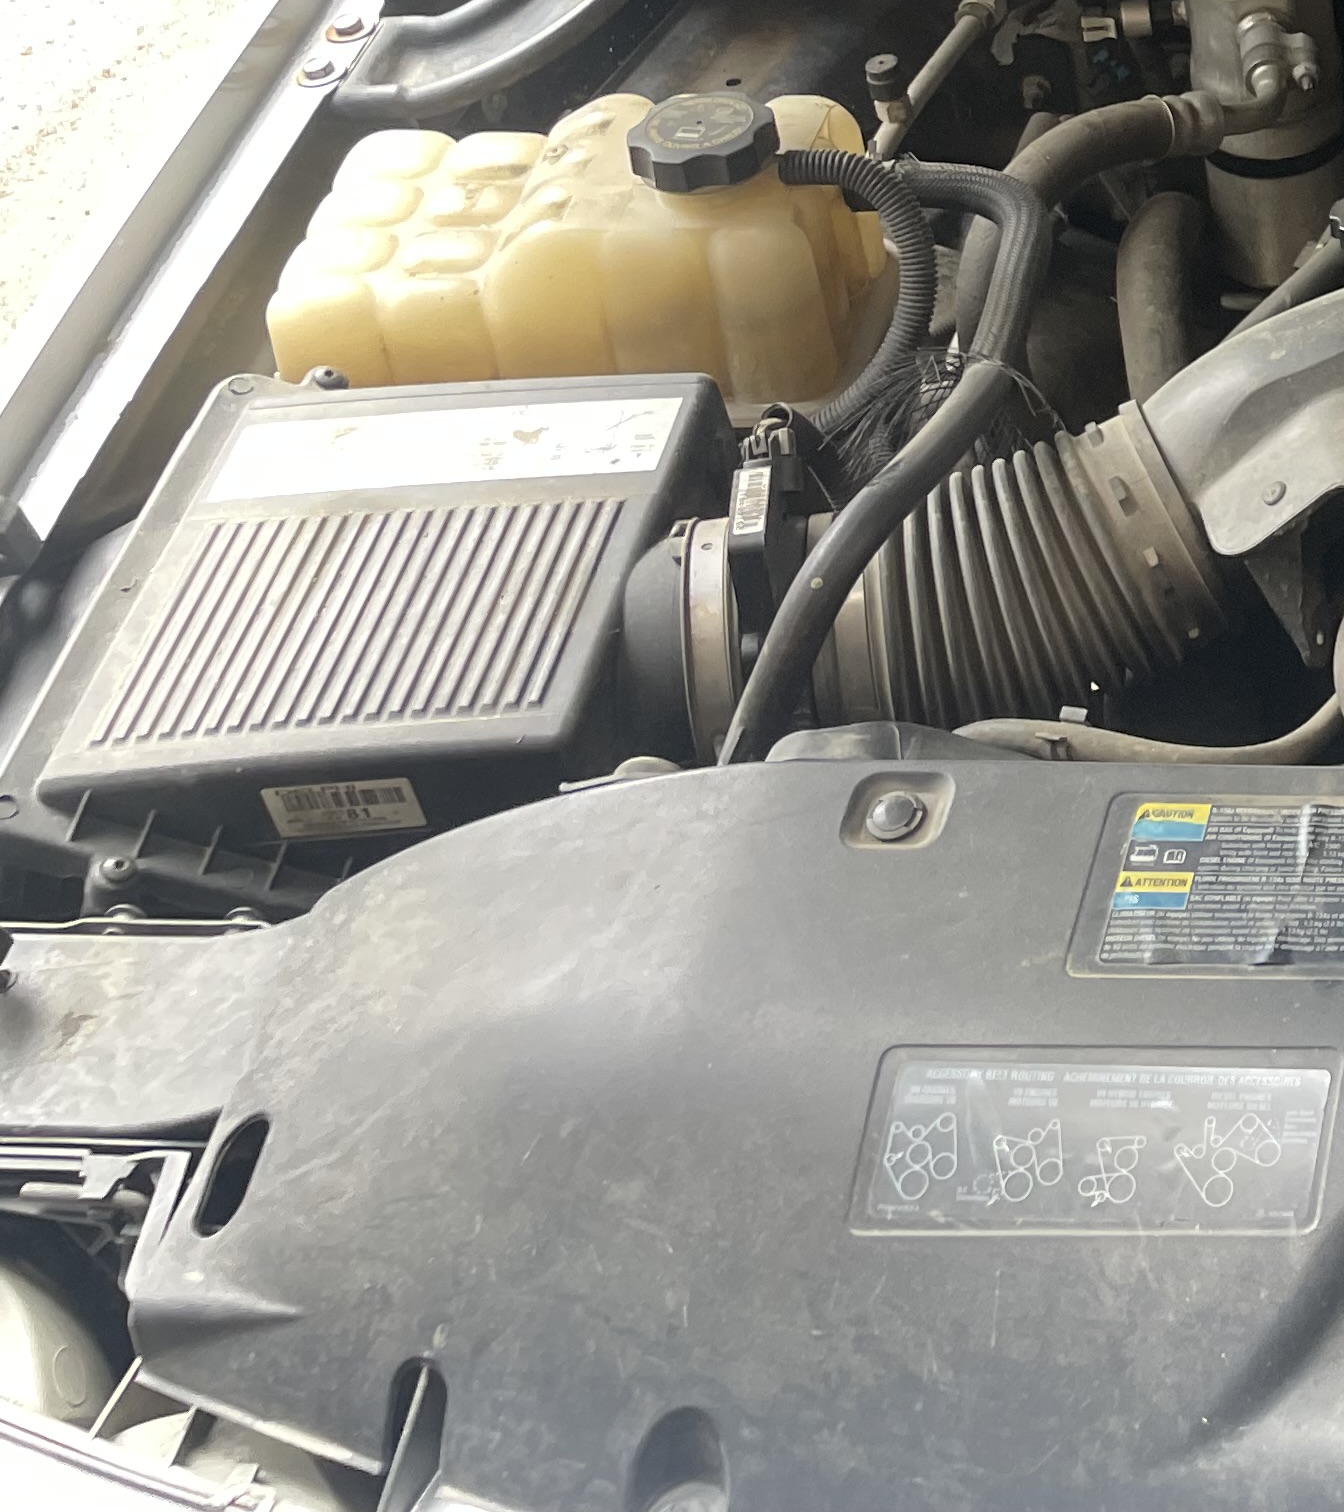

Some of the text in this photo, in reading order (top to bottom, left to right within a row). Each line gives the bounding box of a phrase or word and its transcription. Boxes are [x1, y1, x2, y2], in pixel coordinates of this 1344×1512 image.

[1151, 809, 1195, 819] CAUTION
[1134, 877, 1188, 888] ATTENTION
[1010, 1070, 1055, 1082] ROUTING
